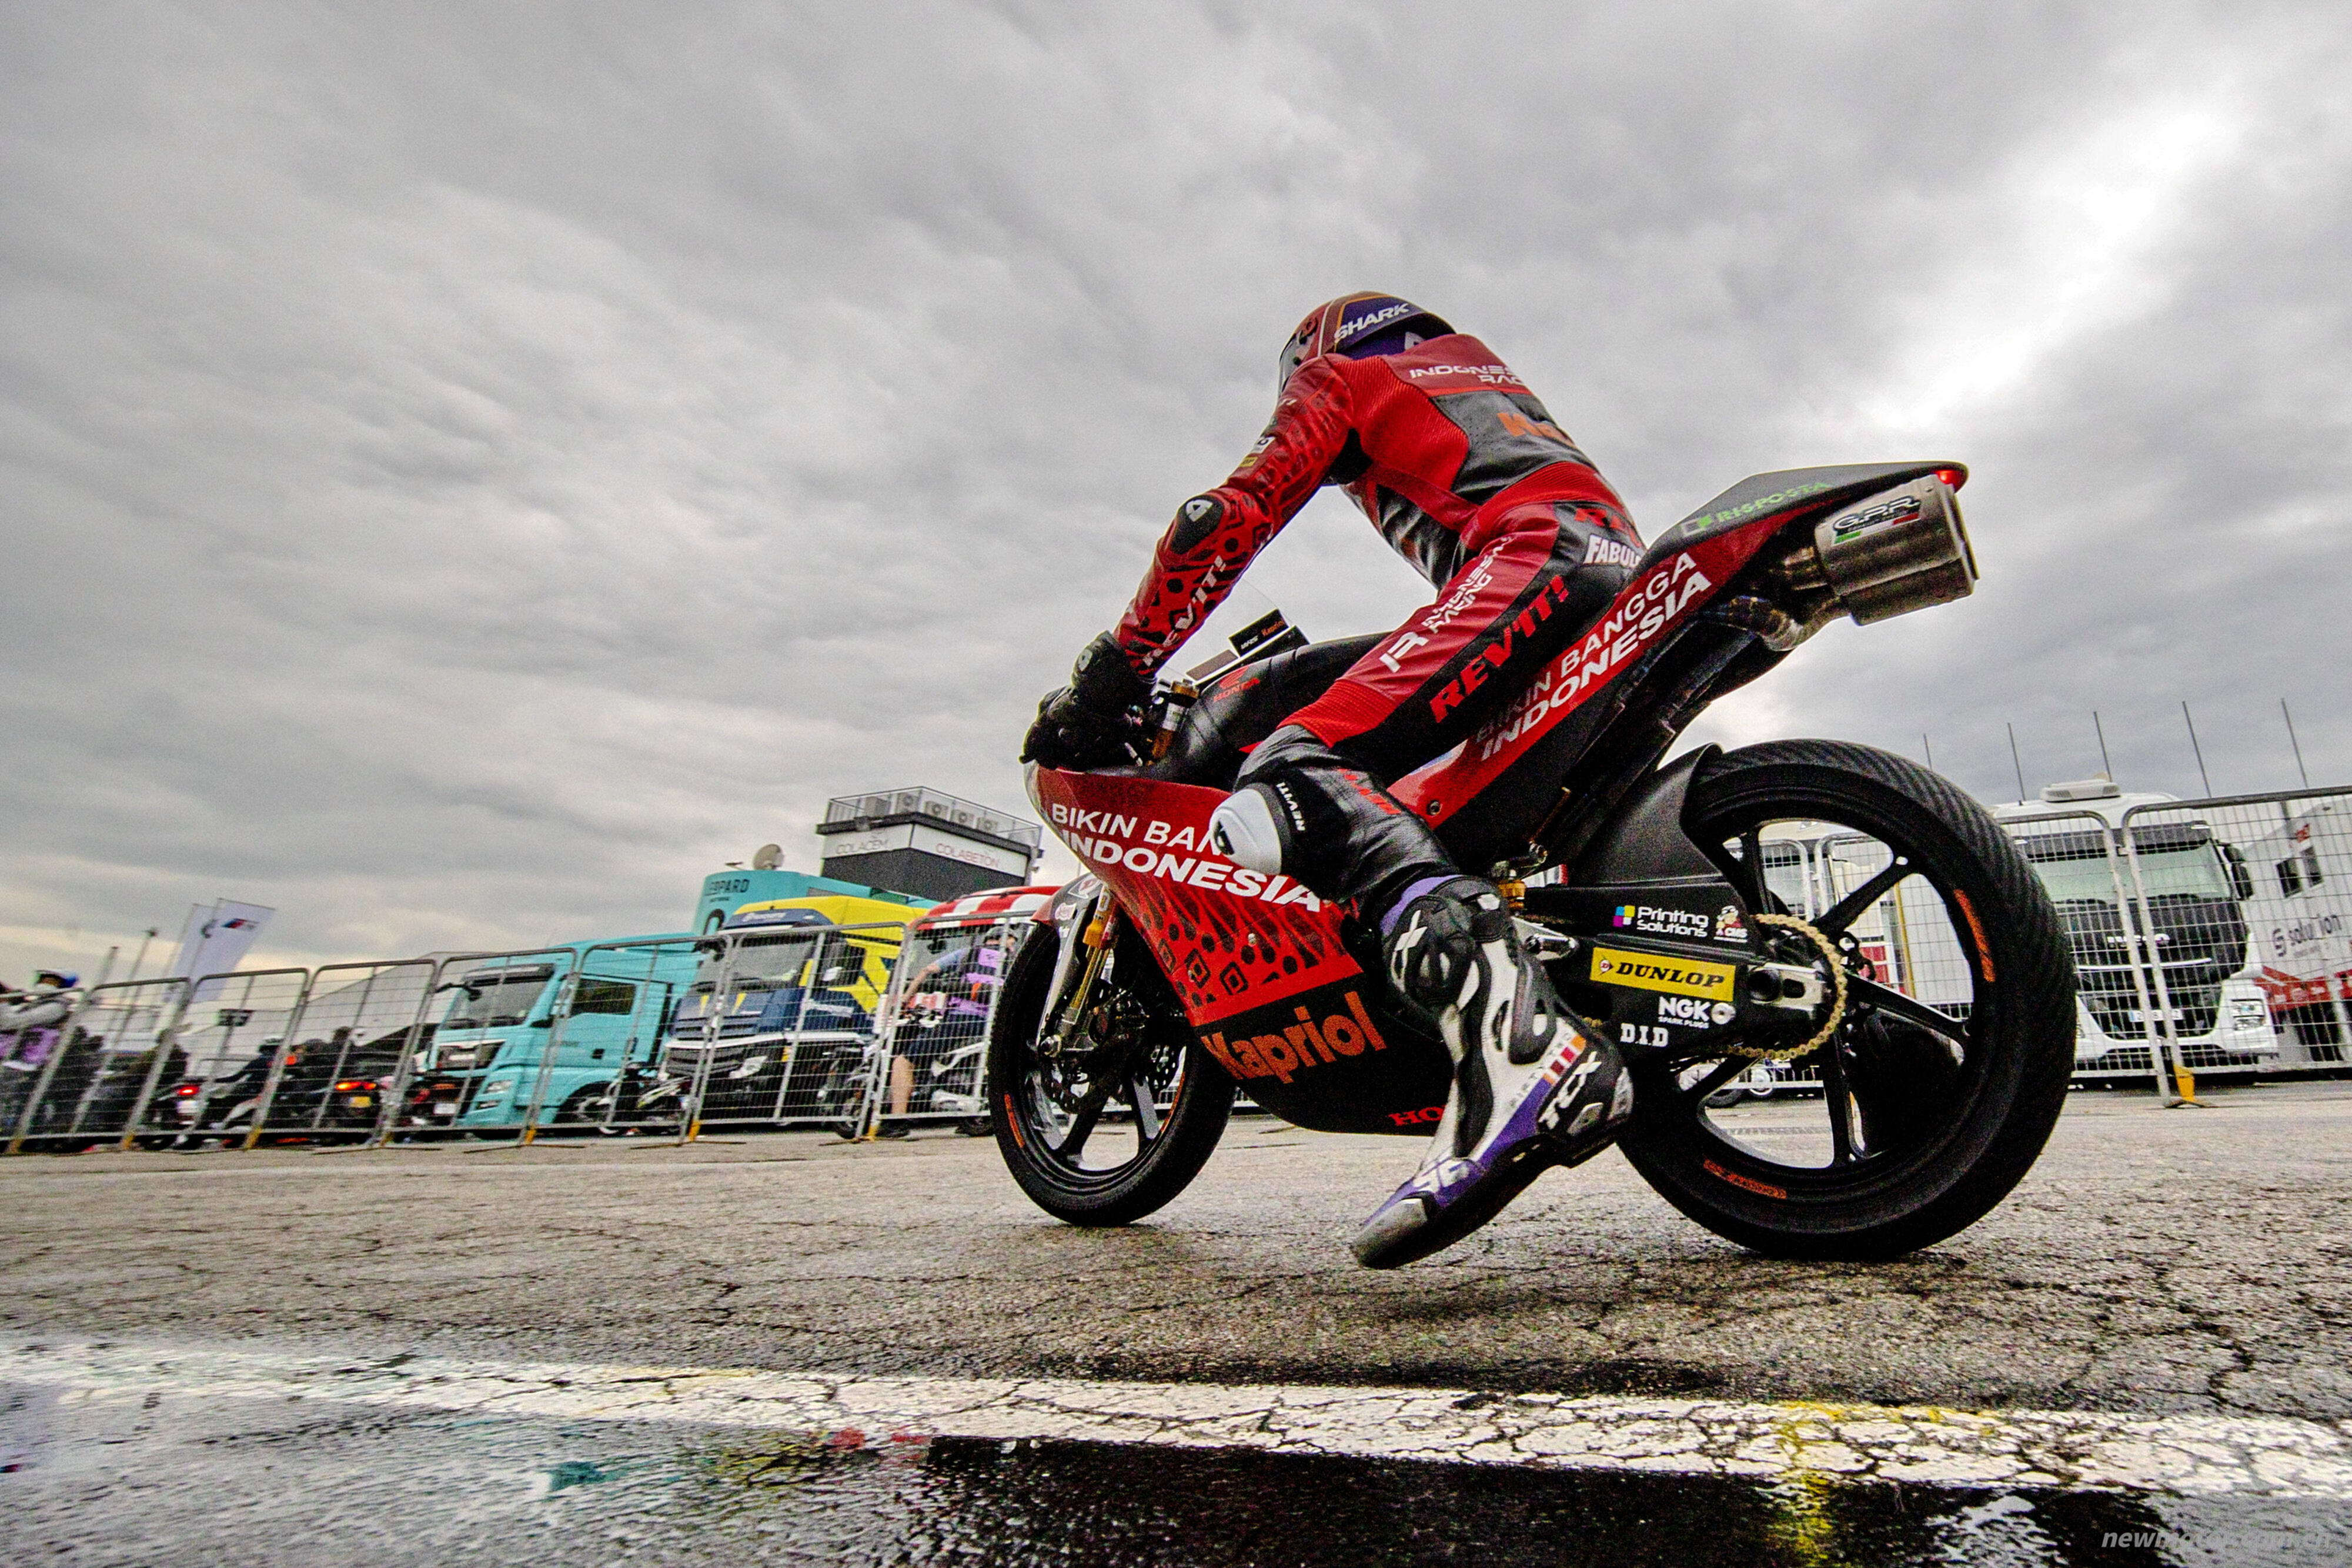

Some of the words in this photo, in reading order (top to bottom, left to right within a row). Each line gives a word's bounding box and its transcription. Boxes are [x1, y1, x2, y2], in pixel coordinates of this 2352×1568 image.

[1334, 303, 1409, 339] SHARK
[1717, 482, 1830, 522] RISPOSTA
[1561, 552, 1696, 678] BANGGA
[1481, 571, 1712, 762] INDONESIA
[1051, 804, 1138, 838] BIKIN
[837, 839, 888, 855] COLACEM
[935, 842, 999, 868] COLABETON
[1062, 830, 1321, 912] INDONESIA
[1636, 919, 1708, 937] Solutions
[1637, 906, 1709, 928] Printing
[1616, 962, 1725, 988] DUNLOP
[1658, 996, 1711, 1022] NGK
[1201, 991, 1388, 1084] Kapriol
[1621, 1022, 1669, 1047] D.I.D
